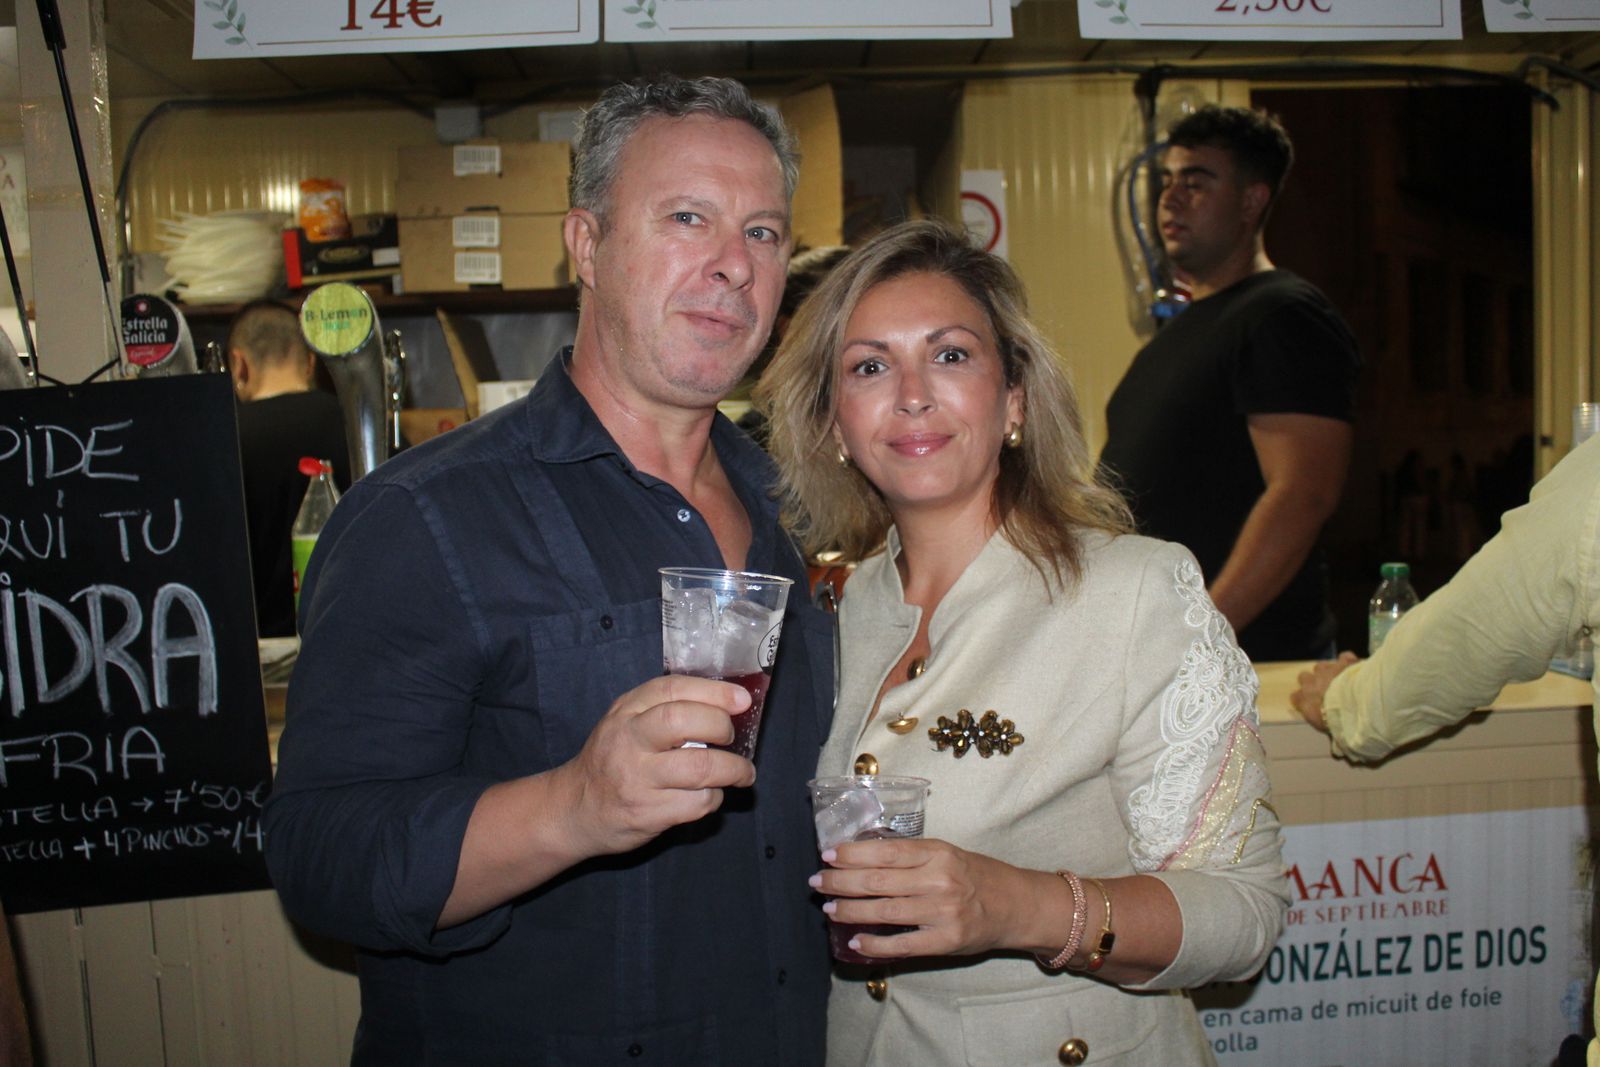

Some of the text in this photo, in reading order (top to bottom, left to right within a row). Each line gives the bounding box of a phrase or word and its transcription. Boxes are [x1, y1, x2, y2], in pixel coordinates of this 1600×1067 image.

[99, 498, 182, 562] TU
[0, 572, 218, 718] IDRA
[0, 796, 118, 825] TELLA
[0, 838, 63, 862] TELLA
[1286, 910, 1306, 926] DE
[1266, 925, 1547, 984] ONZÁLEZ DE DIOS
[1204, 985, 1502, 1028] en cama de micuit de foie
[1208, 1032, 1258, 1053] olla
